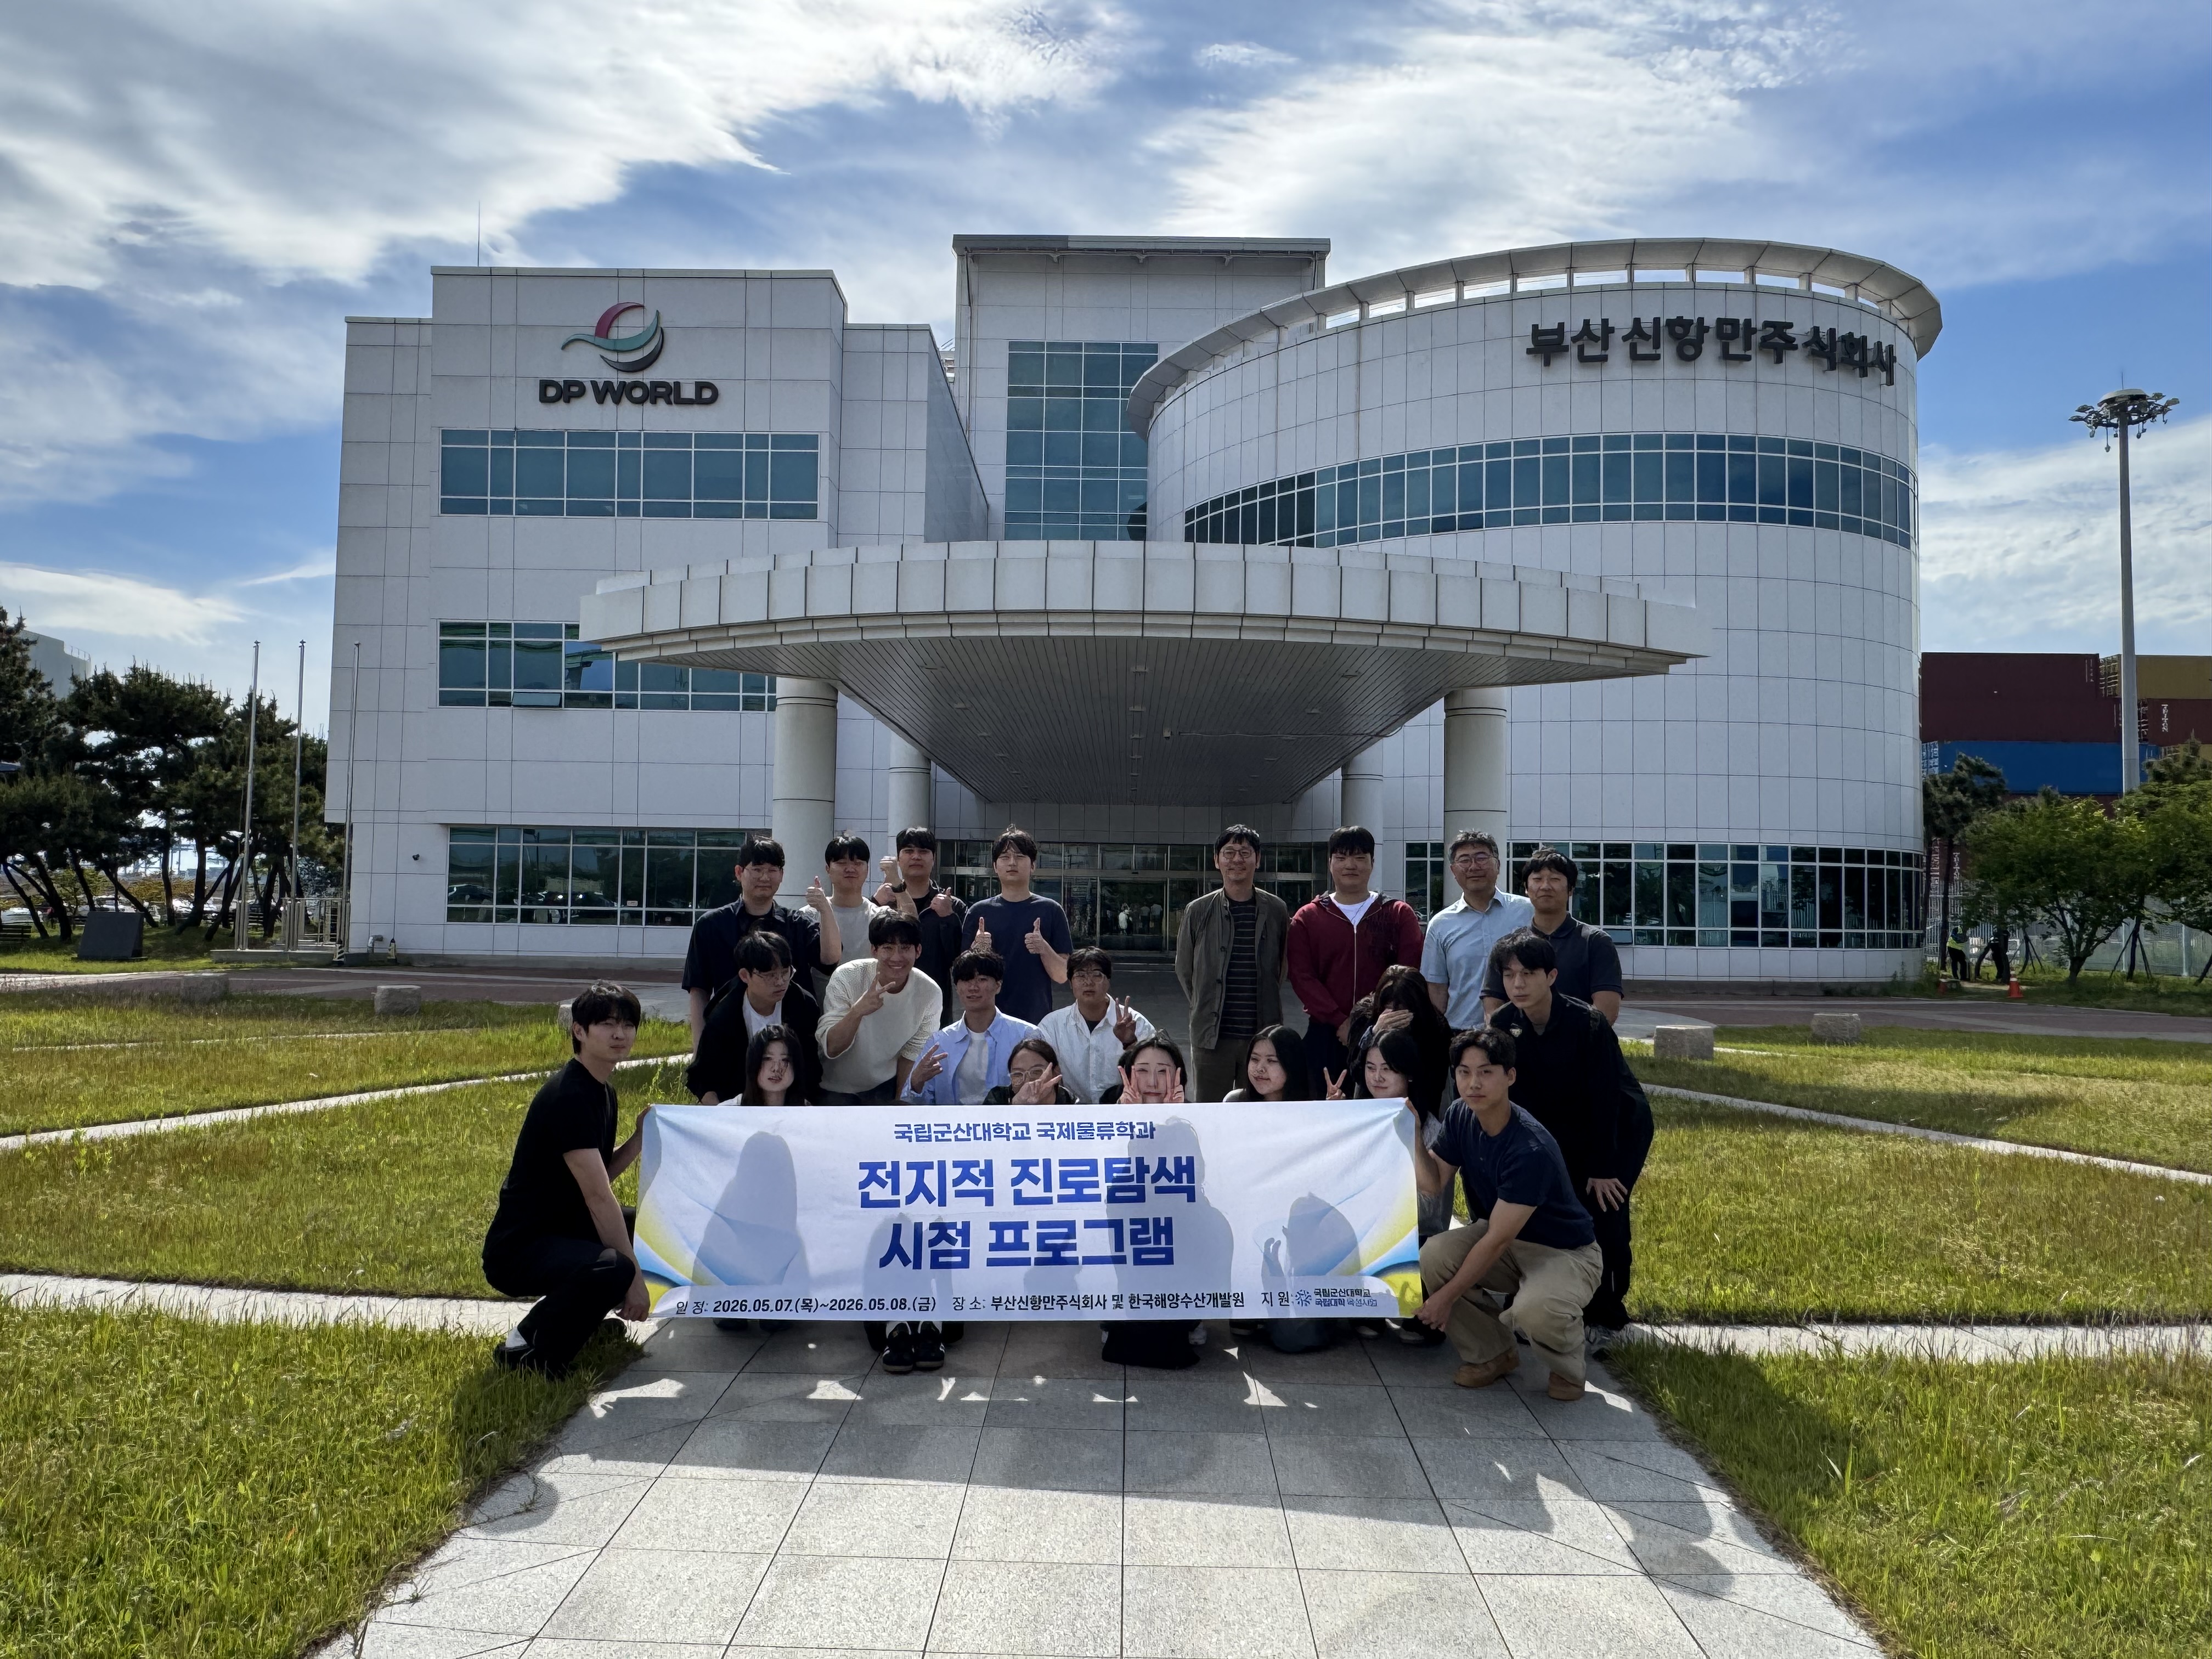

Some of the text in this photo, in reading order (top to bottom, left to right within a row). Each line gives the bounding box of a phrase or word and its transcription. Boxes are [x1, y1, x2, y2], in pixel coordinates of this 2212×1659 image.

[1526, 316, 1897, 386] 부산신항만주식회사
[539, 379, 719, 405] DP WORLD
[894, 1121, 1156, 1143] 국립군산대학교 국제물류학과
[858, 1156, 1196, 1209] 전지적 진로탐색
[879, 1217, 1175, 1270] 시점 프로그램
[991, 1294, 1107, 1311] 부산신항만주식회사
[1111, 1293, 1124, 1310] 및
[1128, 1291, 1245, 1310] 한국해양수산개발원
